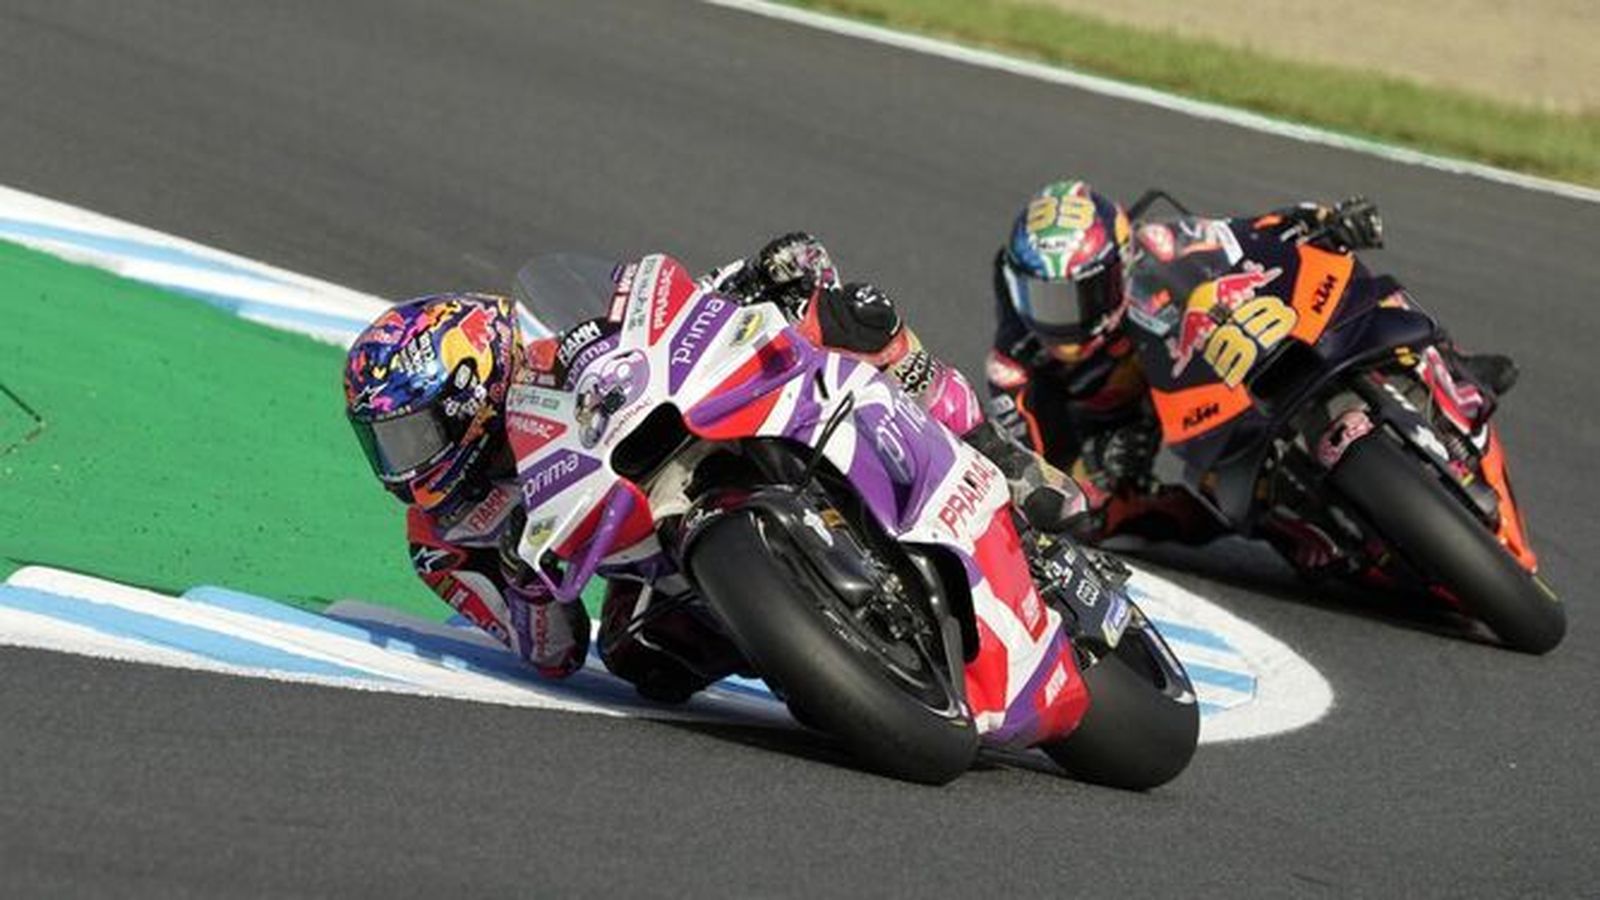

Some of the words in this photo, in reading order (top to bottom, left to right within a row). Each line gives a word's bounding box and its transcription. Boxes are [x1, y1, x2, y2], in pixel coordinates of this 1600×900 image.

[1311, 274, 1337, 315] KTM
[671, 299, 726, 365] prima
[1204, 295, 1297, 388] 33
[1182, 402, 1220, 431] KTM
[522, 453, 580, 506] prima
